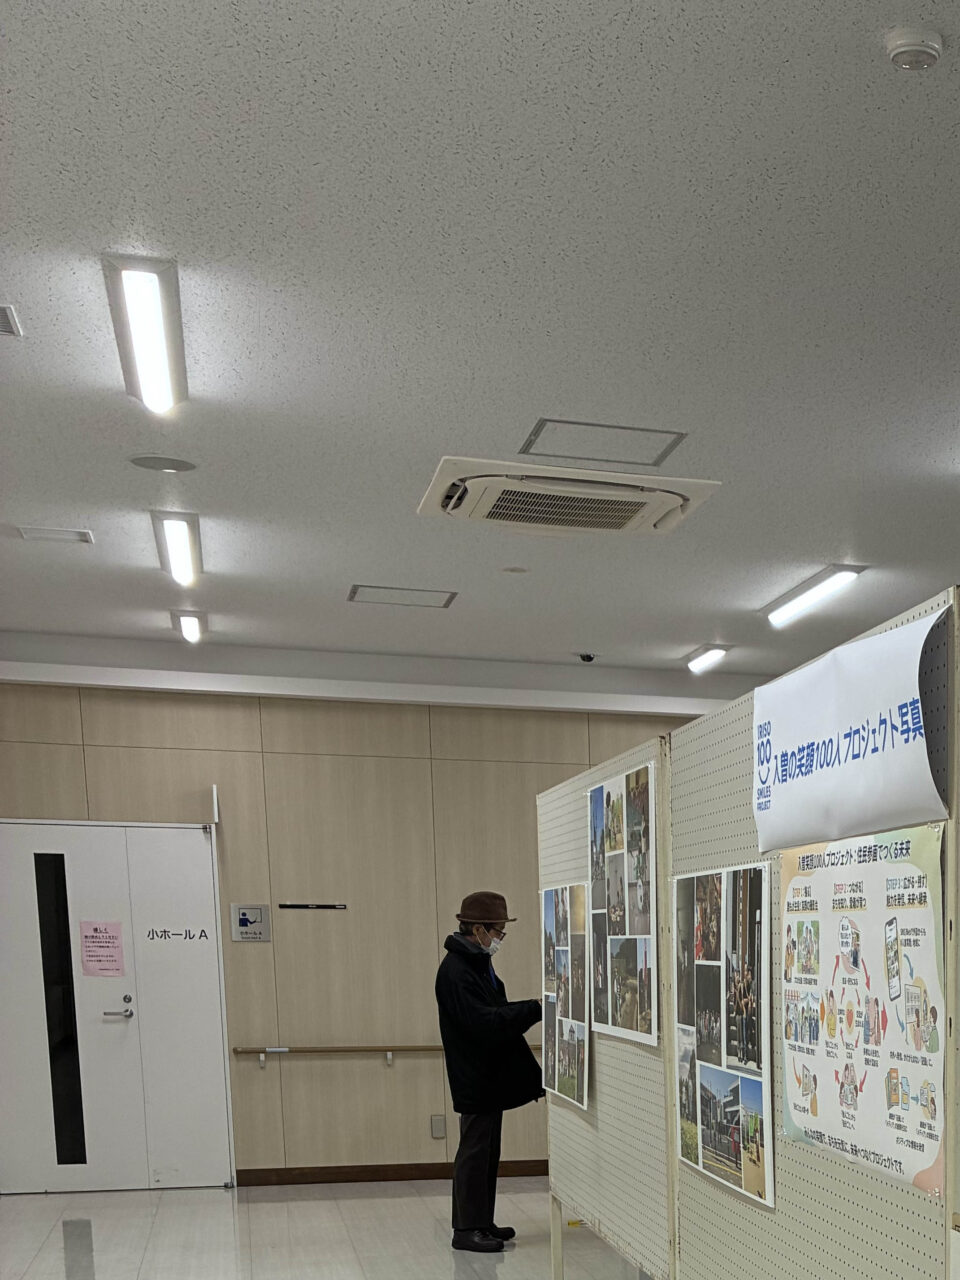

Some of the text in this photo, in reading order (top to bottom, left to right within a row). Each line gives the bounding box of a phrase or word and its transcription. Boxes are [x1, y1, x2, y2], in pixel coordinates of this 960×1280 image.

[757, 721, 771, 740] IRISO
[773, 697, 924, 785] 入曽の笑顔100人プロジェクト写真
[757, 740, 772, 767] 100
[757, 785, 771, 800] SMILES
[147, 928, 209, 941] 小ホール A
